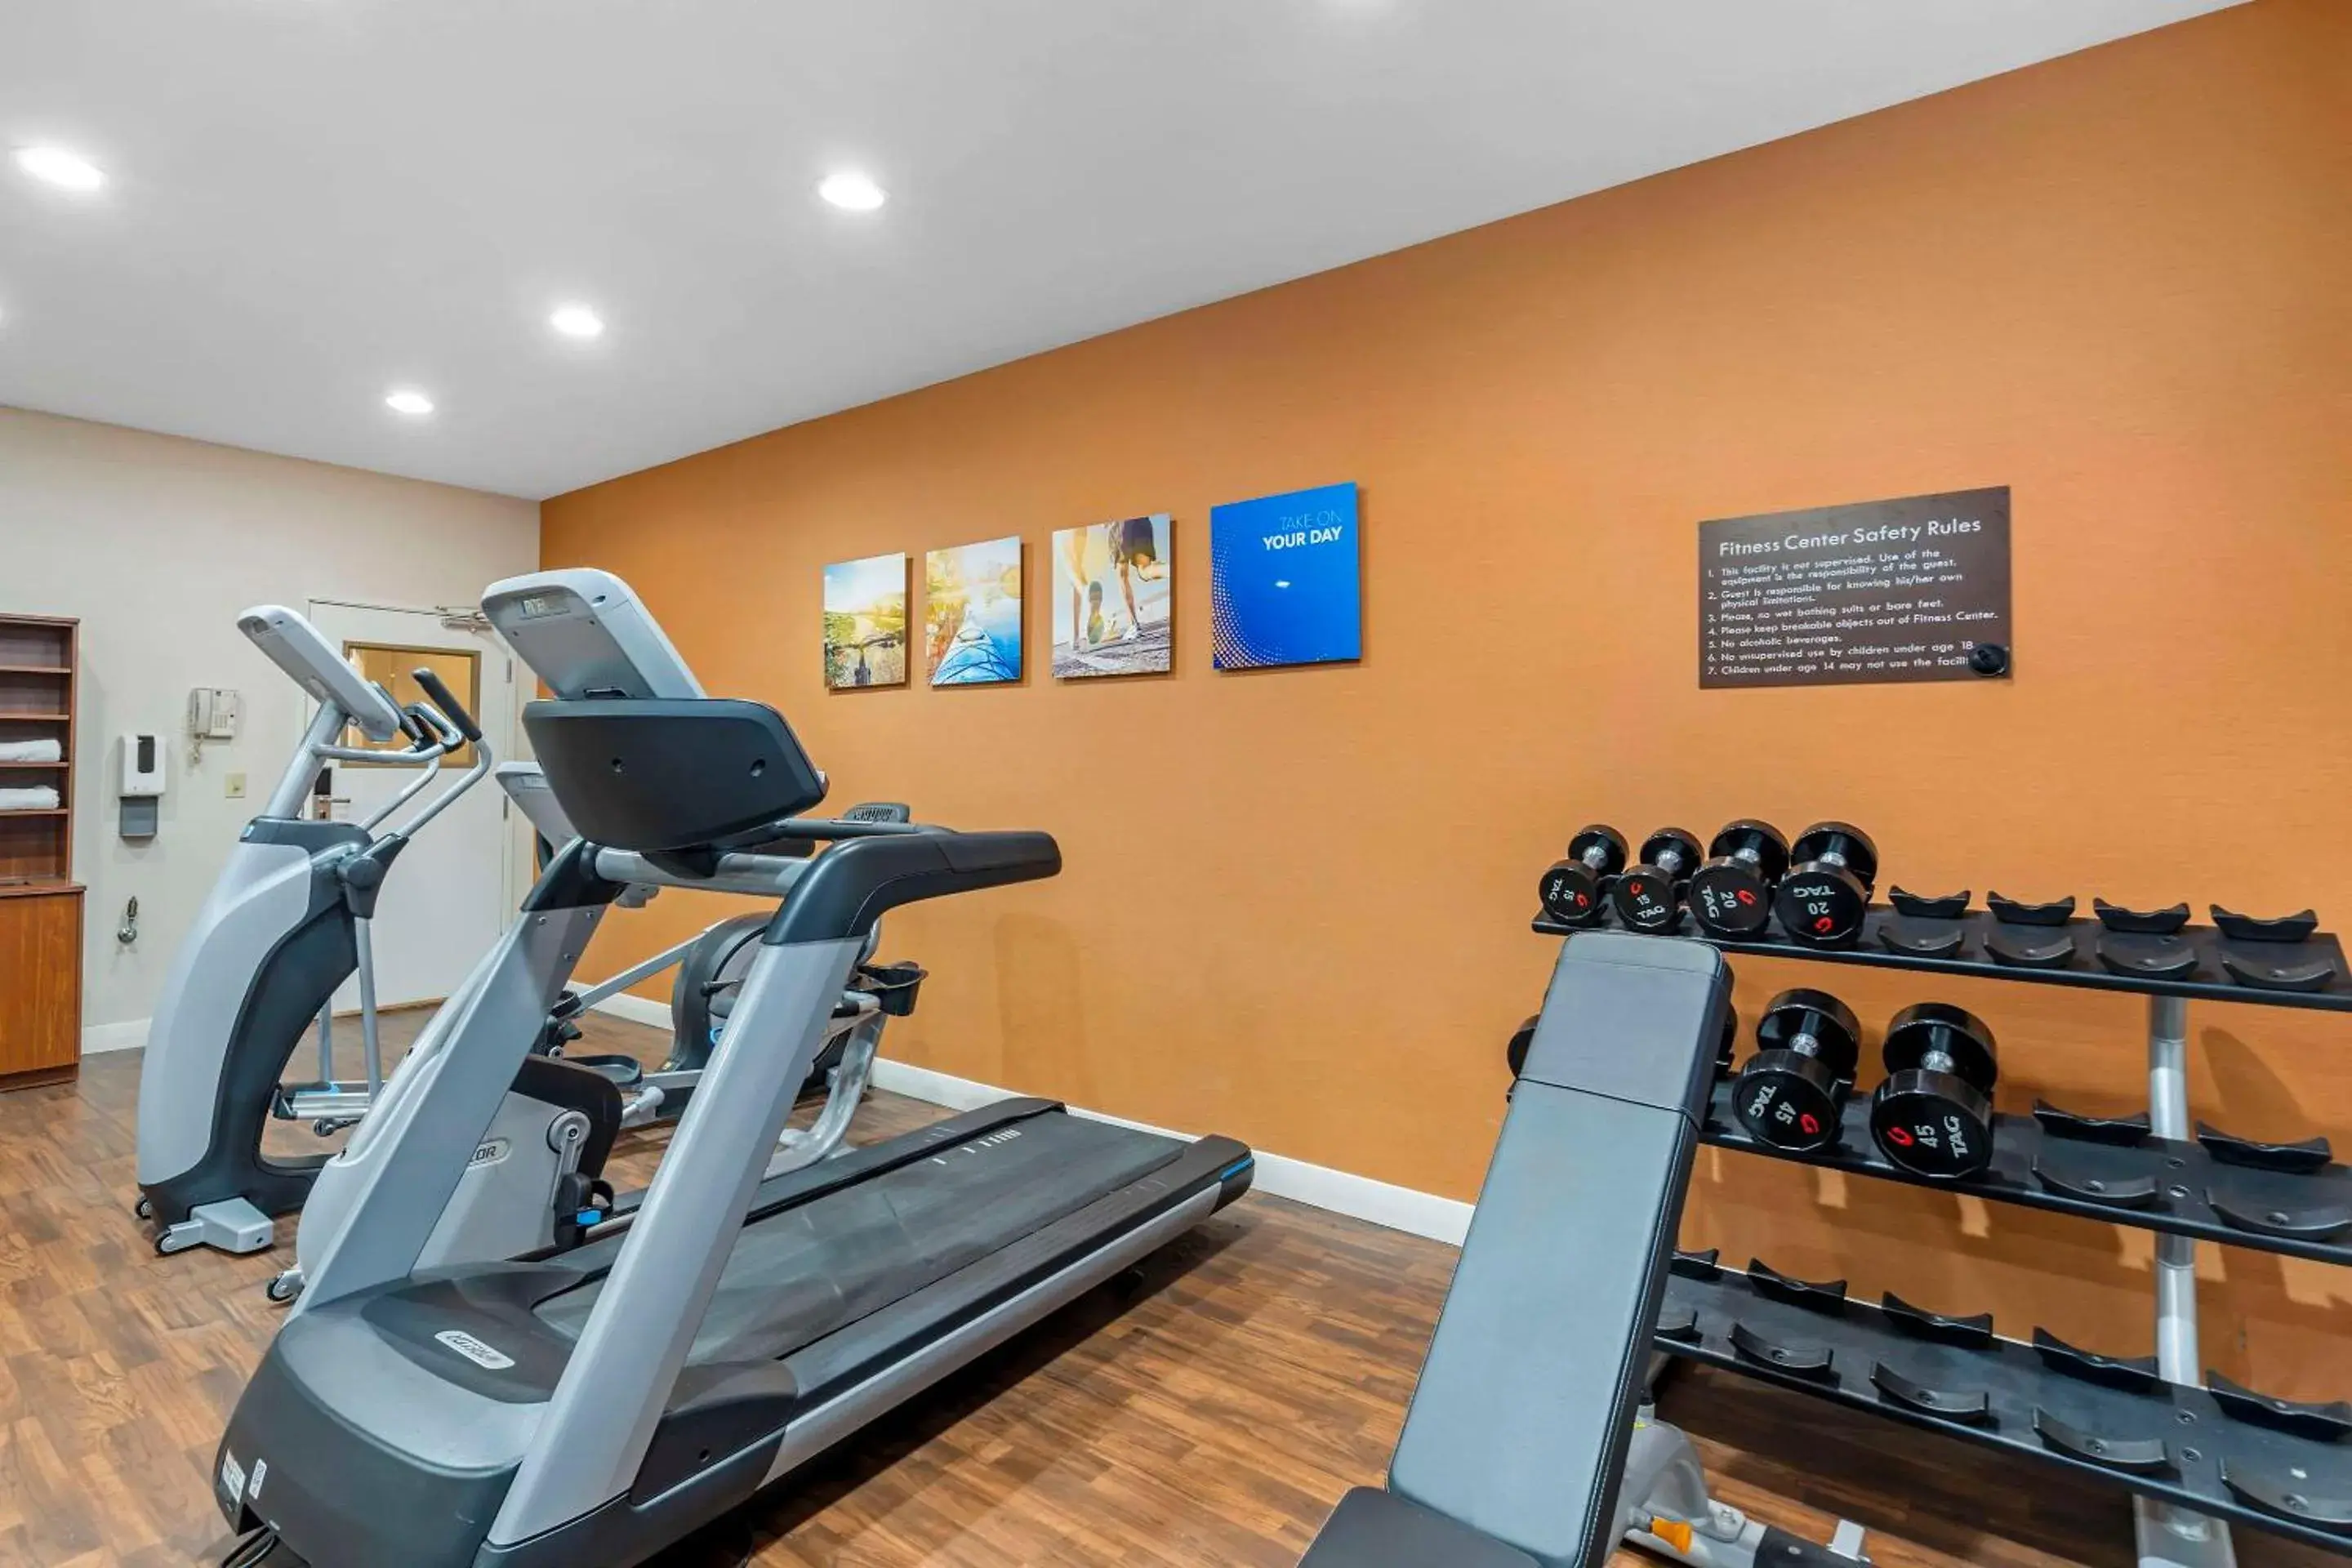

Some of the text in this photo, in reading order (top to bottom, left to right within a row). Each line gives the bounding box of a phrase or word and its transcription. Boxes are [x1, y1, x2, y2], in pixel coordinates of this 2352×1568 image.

[1280, 510, 1342, 531] TAKE ON
[1263, 526, 1343, 550] YOUR DAY
[1719, 518, 1981, 557] Fitness Center Safety Rules
[1721, 568, 1739, 577] This
[1743, 564, 1777, 574] facility
[1782, 562, 1790, 571] is
[1793, 561, 1811, 570] not
[1879, 553, 1899, 563] Use
[1904, 550, 1917, 560] of
[1922, 549, 1940, 559] the
[1721, 559, 1957, 586] equipment is the responsibility of the guest.
[1708, 574, 1962, 600] 2. Guest is responsible for knowing his/her own
[1721, 598, 1758, 609] physical
[1775, 609, 1792, 617] wet
[1797, 606, 1837, 617] bathing
[1841, 604, 1864, 614] suits
[1869, 604, 1881, 612] or
[1886, 601, 1912, 611] bare
[1721, 626, 1752, 635] Please
[1754, 625, 1778, 633] keep
[1781, 621, 1832, 631] breakable
[1836, 617, 1873, 630] objects
[1877, 617, 1894, 625] out
[1898, 614, 1909, 624] of
[1913, 612, 1952, 624] Fitness
[1721, 639, 1735, 648] No
[1740, 637, 1782, 647] alcoholic
[1721, 653, 1735, 662] No
[1739, 649, 1803, 662] unsupervised
[1829, 648, 1842, 658] by
[1848, 645, 1890, 655] children
[1894, 643, 1926, 653] under
[1931, 644, 1954, 653] age
[1721, 666, 1760, 675] Children
[1764, 664, 1793, 673] under
[1797, 664, 1817, 673] age
[1824, 662, 1834, 670] 14
[1839, 662, 1861, 670] may
[1867, 661, 1884, 669] not
[1913, 658, 1931, 666] the
[1548, 878, 1563, 901] TAG
[1720, 891, 1738, 909] 20
[1793, 885, 1836, 898] TAG
[1637, 905, 1666, 919] TAG
[1701, 885, 1720, 920] TAG
[1807, 901, 1830, 915] 20
[1748, 1085, 1776, 1119] TAG
[1775, 1102, 1796, 1125] 45
[1915, 1125, 1940, 1148] 45
[1944, 1116, 1969, 1159] TAG
